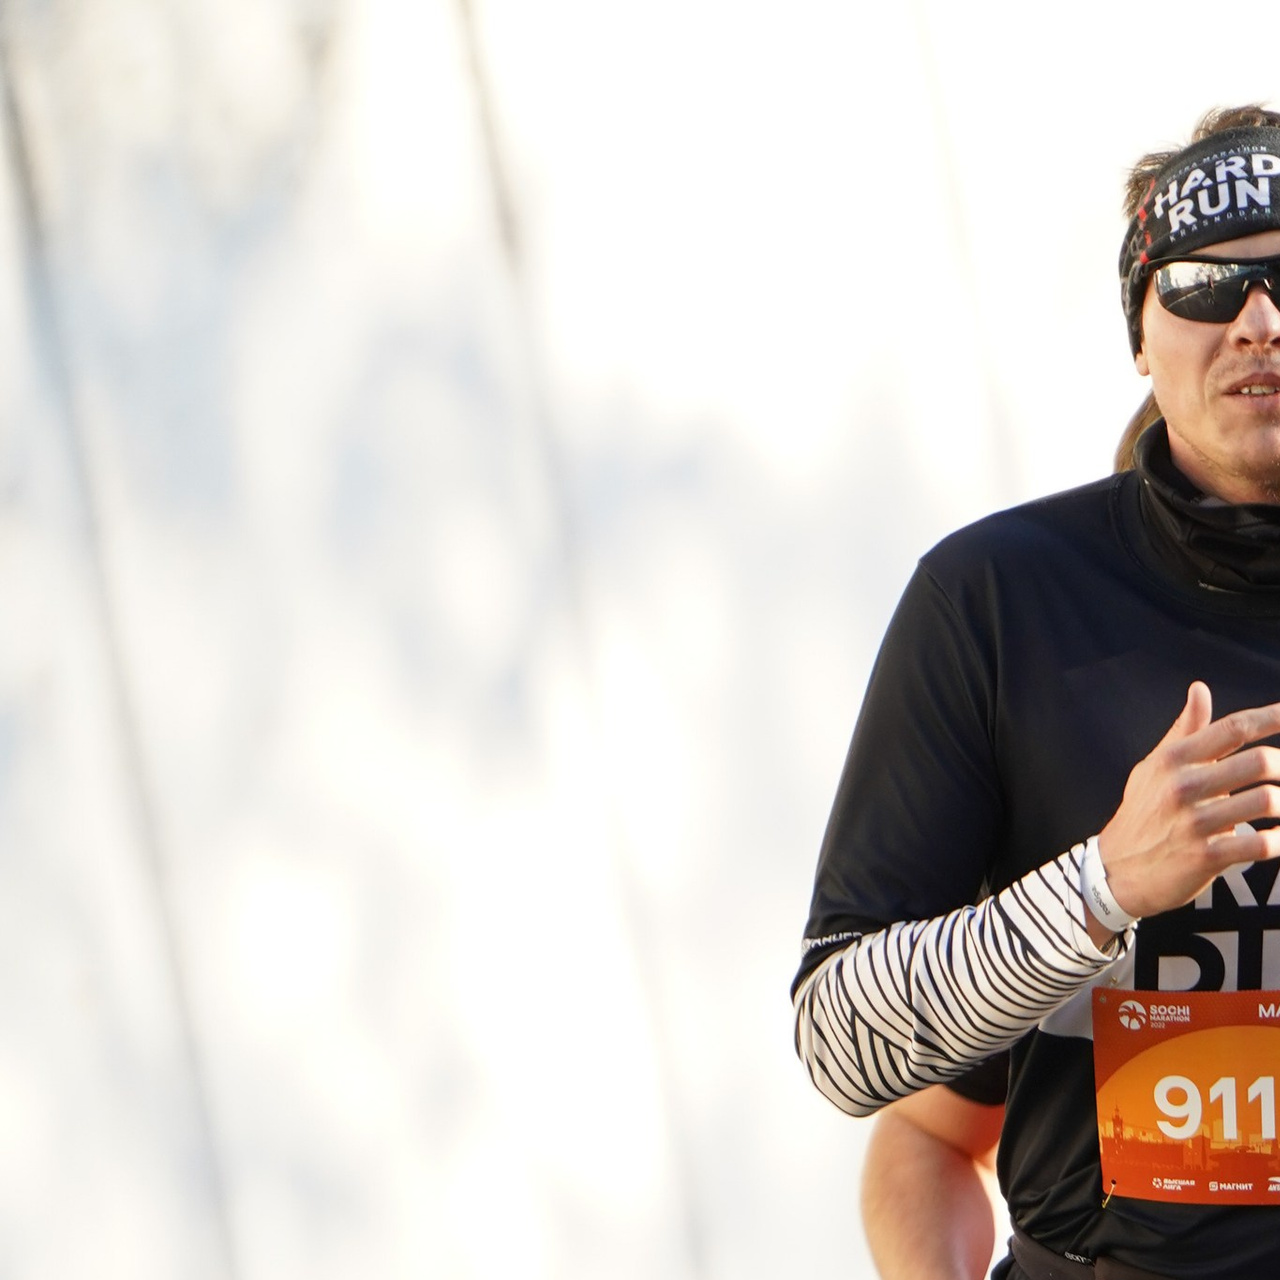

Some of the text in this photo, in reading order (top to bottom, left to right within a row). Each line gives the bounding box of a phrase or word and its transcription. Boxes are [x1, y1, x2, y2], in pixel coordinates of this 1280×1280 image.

[1168, 176, 1271, 233] RUN
[1169, 206, 1271, 243] KRASNODAR
[1149, 1004, 1190, 1016] SOCHI
[1149, 1014, 1190, 1023] MARATHON
[1219, 1182, 1254, 1191] МАГНИТ
